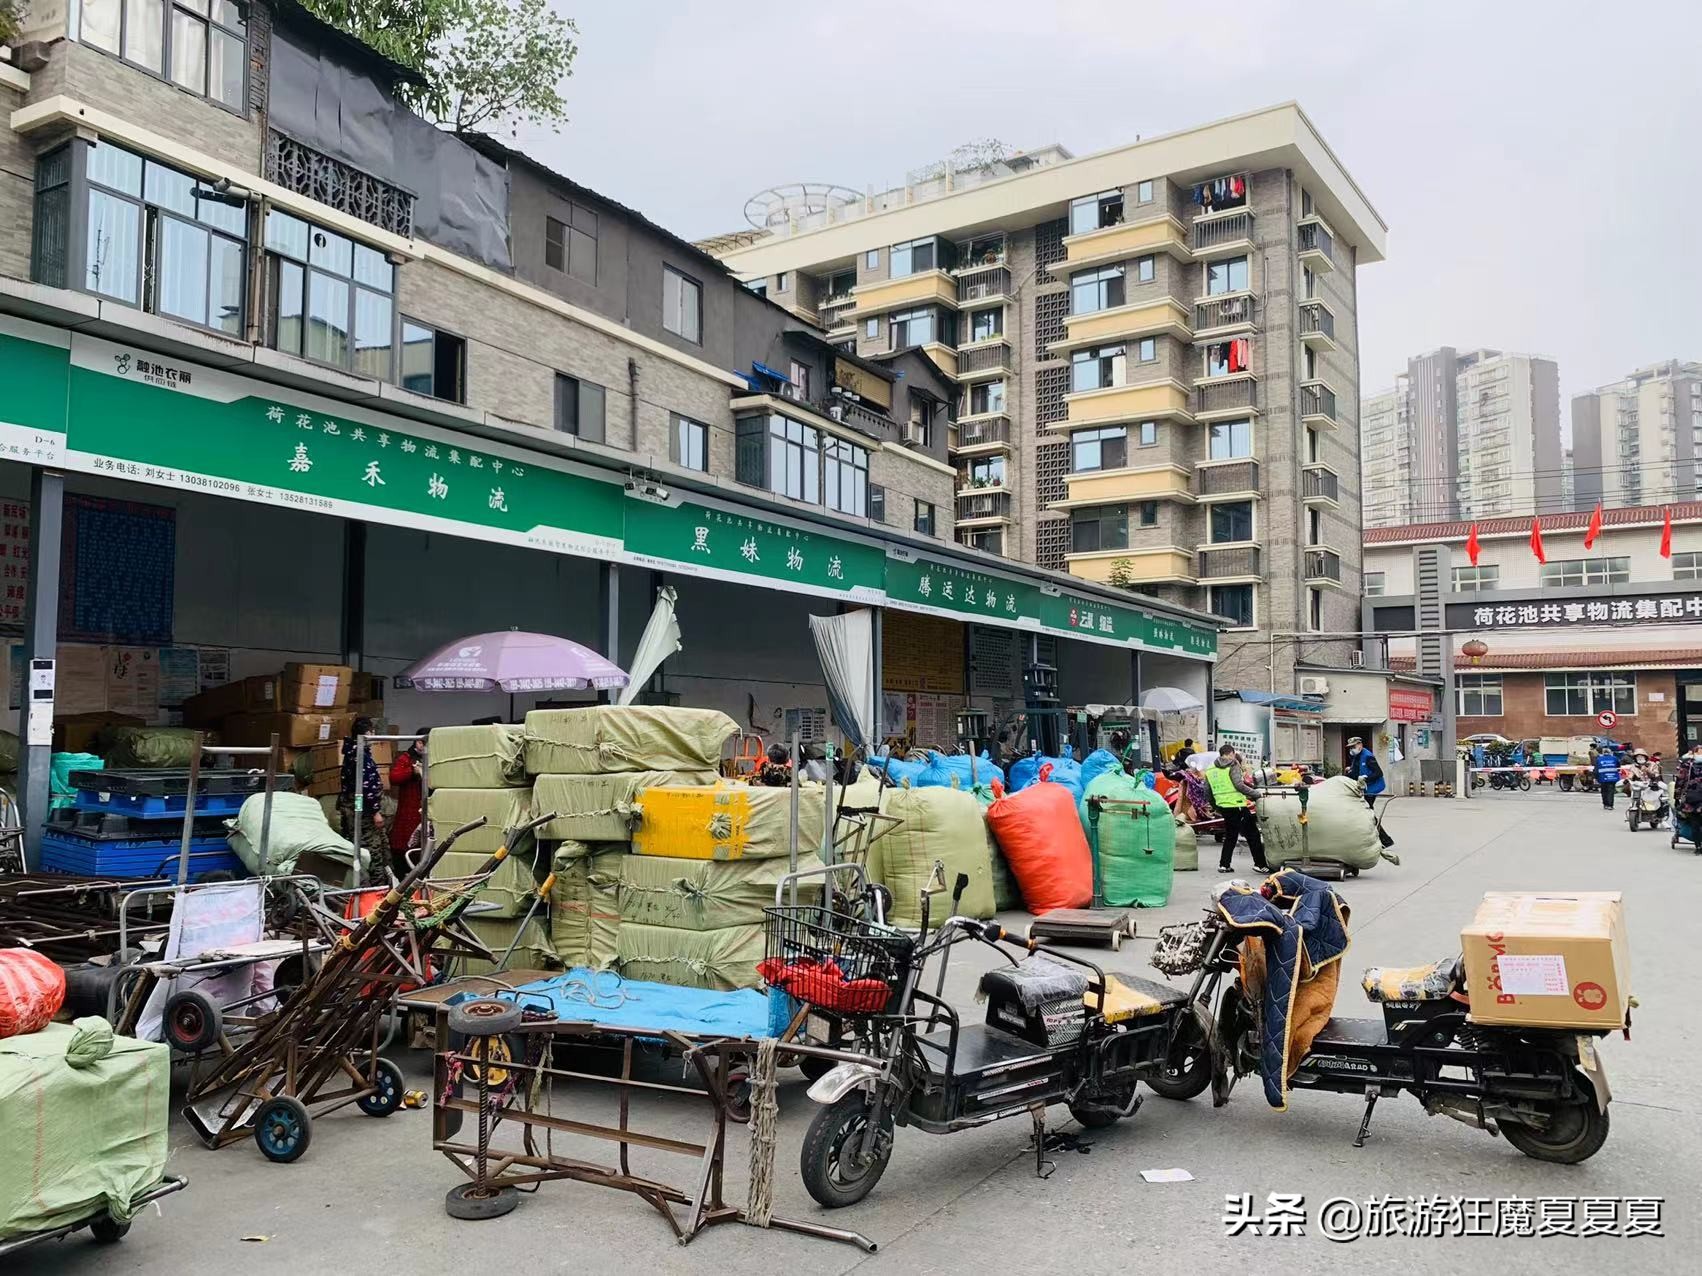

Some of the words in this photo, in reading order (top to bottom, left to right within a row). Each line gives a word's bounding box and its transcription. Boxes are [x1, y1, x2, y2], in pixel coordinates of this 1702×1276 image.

[137, 359, 192, 384] 融池衣丽
[265, 405, 525, 478] 荷花池共享物流集配中心
[144, 466, 176, 481] 刘女士
[179, 474, 240, 493] 13038102096
[247, 485, 274, 499] 张女士
[287, 441, 508, 513] 嘉禾物流
[918, 573, 1017, 614] 腾运达物流
[1473, 596, 1702, 625] 荷花池共享物流集配中
